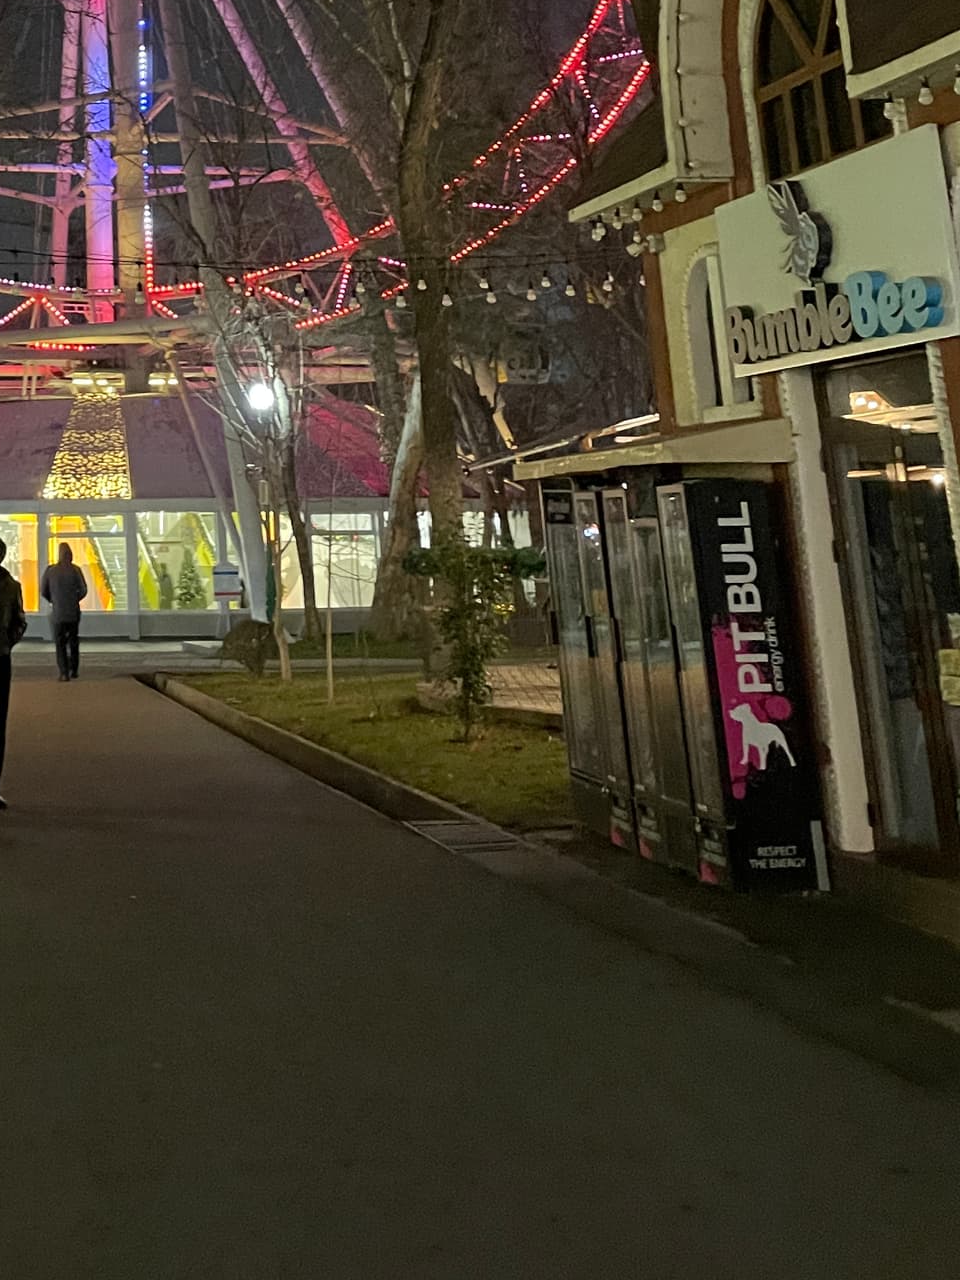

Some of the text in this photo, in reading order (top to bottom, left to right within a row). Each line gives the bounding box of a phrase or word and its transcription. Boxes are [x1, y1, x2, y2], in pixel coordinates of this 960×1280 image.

[717, 501, 773, 692] PIT BULL
[763, 616, 785, 692] energy drink
[749, 858, 806, 869] THE ENERGY
[757, 845, 797, 856] RESPECT
